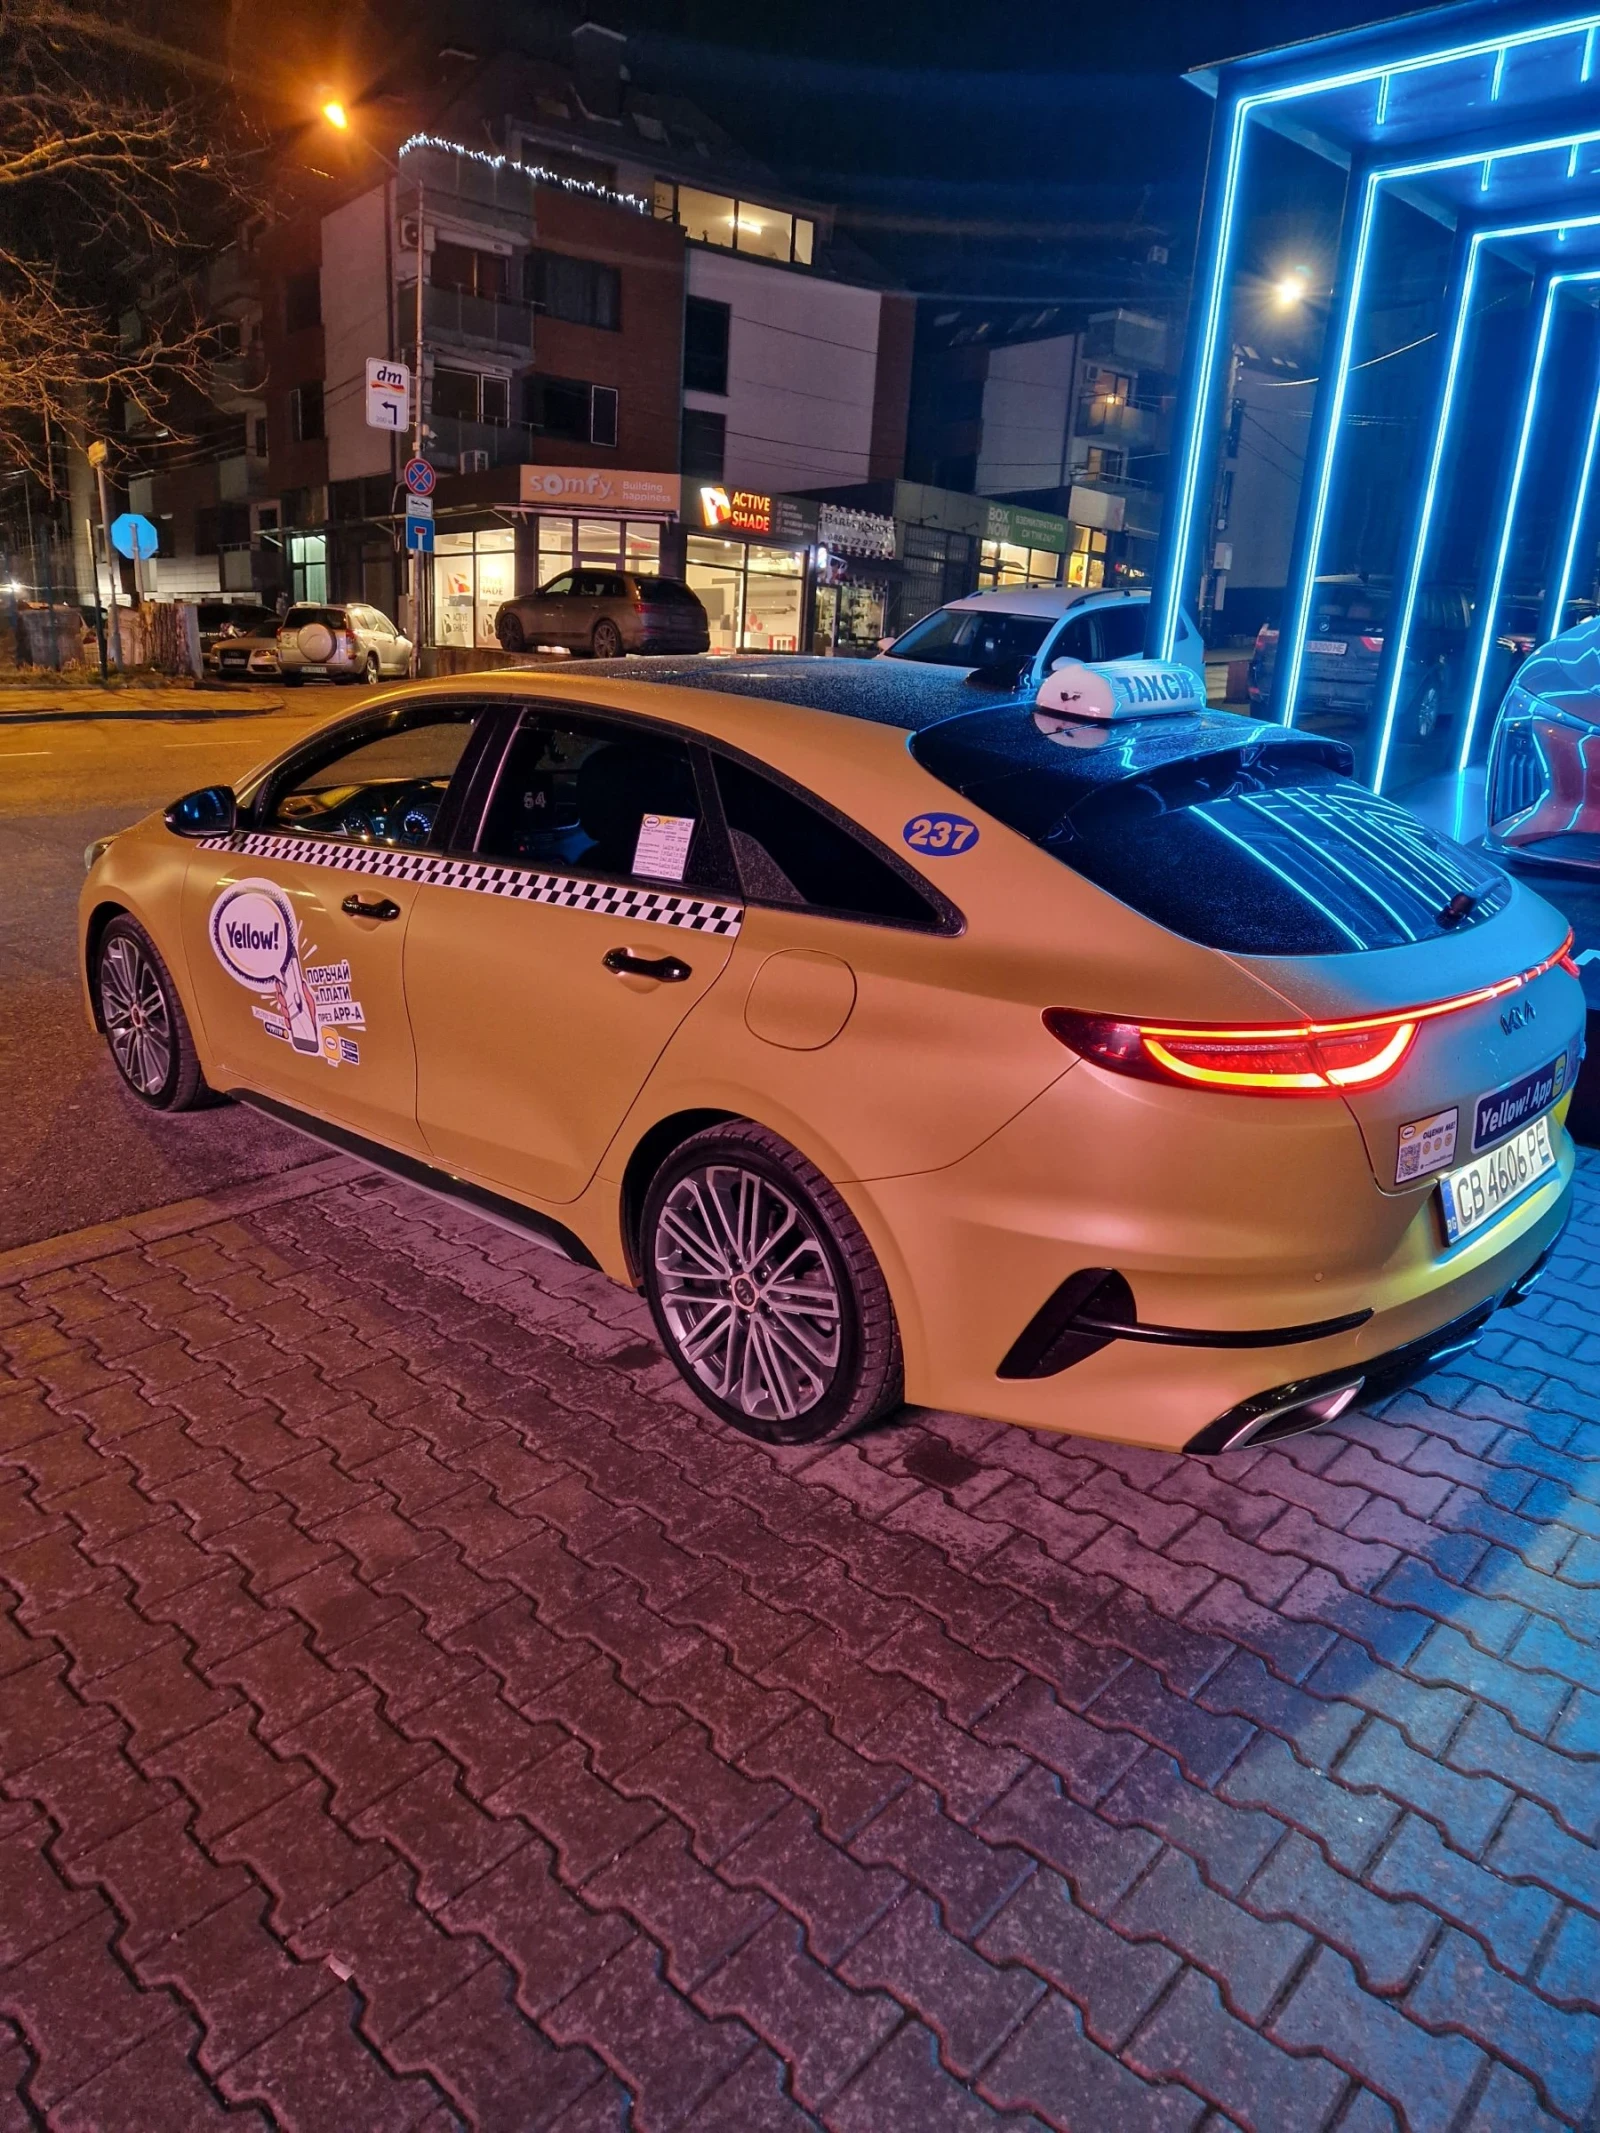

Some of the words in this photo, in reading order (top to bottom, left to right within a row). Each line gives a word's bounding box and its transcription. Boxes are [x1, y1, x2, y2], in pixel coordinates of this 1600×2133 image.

[377, 366, 402, 384] dm
[530, 473, 612, 498] somfy
[623, 481, 663, 493] Building
[622, 491, 671, 502] happiness
[732, 492, 770, 511] ACTIVE
[731, 511, 770, 531] SHADE
[989, 507, 1009, 523] BOX
[987, 521, 1010, 537] NOW
[1116, 674, 1195, 704] ТАКСИ
[908, 818, 975, 850] 237
[226, 921, 279, 950] Yellow!
[307, 962, 350, 983] ПОРЪЧАЙ
[320, 986, 350, 1002] ПЛАТИ
[318, 1012, 333, 1022] ПРЕЗ
[1481, 1088, 1531, 1136] Yellow!
[1531, 1078, 1552, 1109] App
[1422, 1126, 1445, 1140] ОЦЕНИ
[1445, 1121, 1456, 1132] МЕ!
[1446, 1214, 1458, 1233] BG
